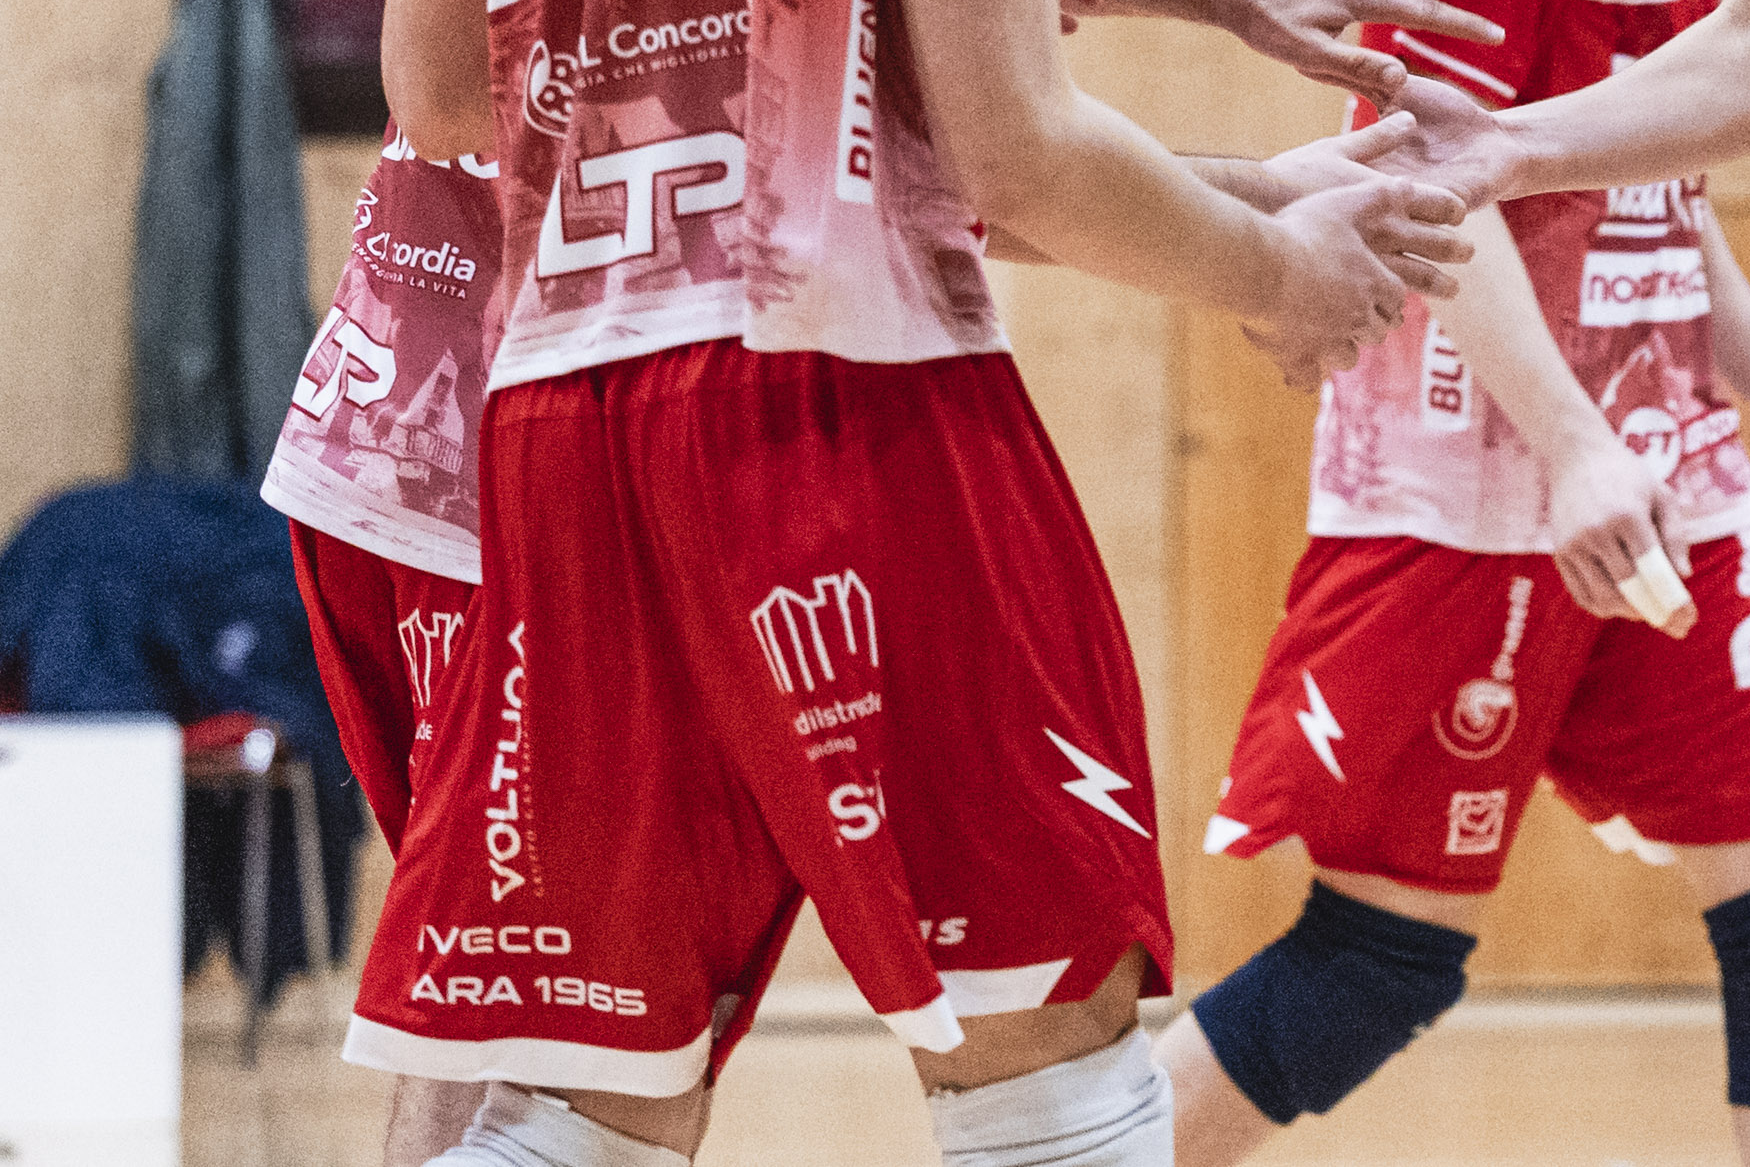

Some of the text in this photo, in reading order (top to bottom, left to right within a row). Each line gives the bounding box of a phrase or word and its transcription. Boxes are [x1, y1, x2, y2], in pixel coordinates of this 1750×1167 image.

[433, 281, 467, 299] VITA
[417, 924, 572, 956] IVECO
[410, 973, 648, 1017] ARA 1965
